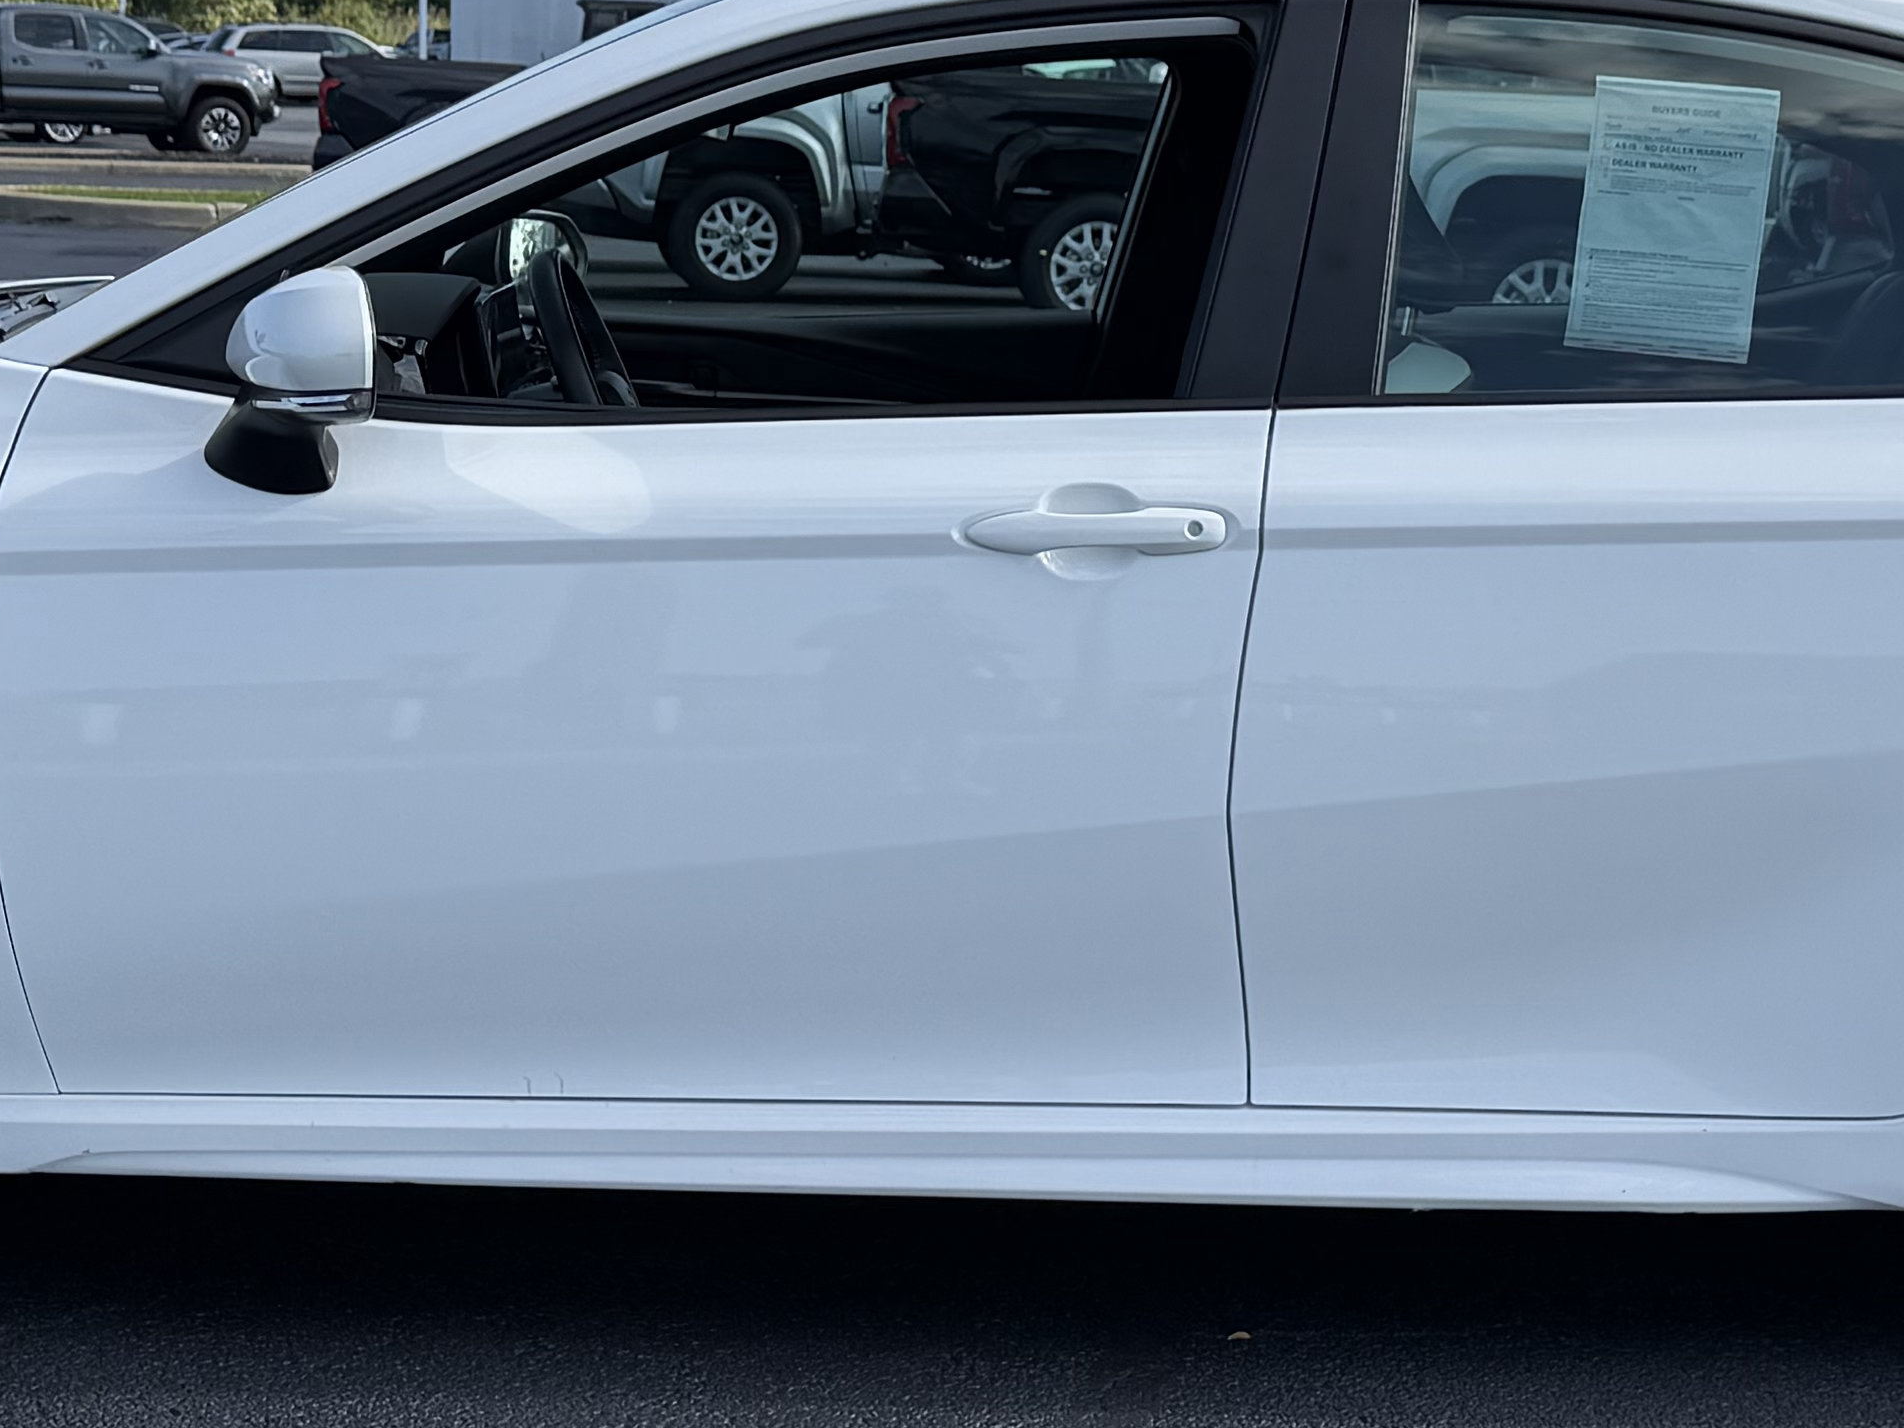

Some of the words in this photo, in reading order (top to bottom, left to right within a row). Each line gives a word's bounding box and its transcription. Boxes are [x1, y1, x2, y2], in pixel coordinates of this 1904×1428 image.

[1651, 105, 1690, 117] BUYERS
[1693, 108, 1722, 120] GUIDE
[1644, 144, 1657, 152] NO
[1659, 145, 1694, 155] DEALER
[1696, 148, 1745, 159] WARRANTY
[1612, 158, 1647, 168] DEALER
[1649, 162, 1697, 173] WARRANTY
